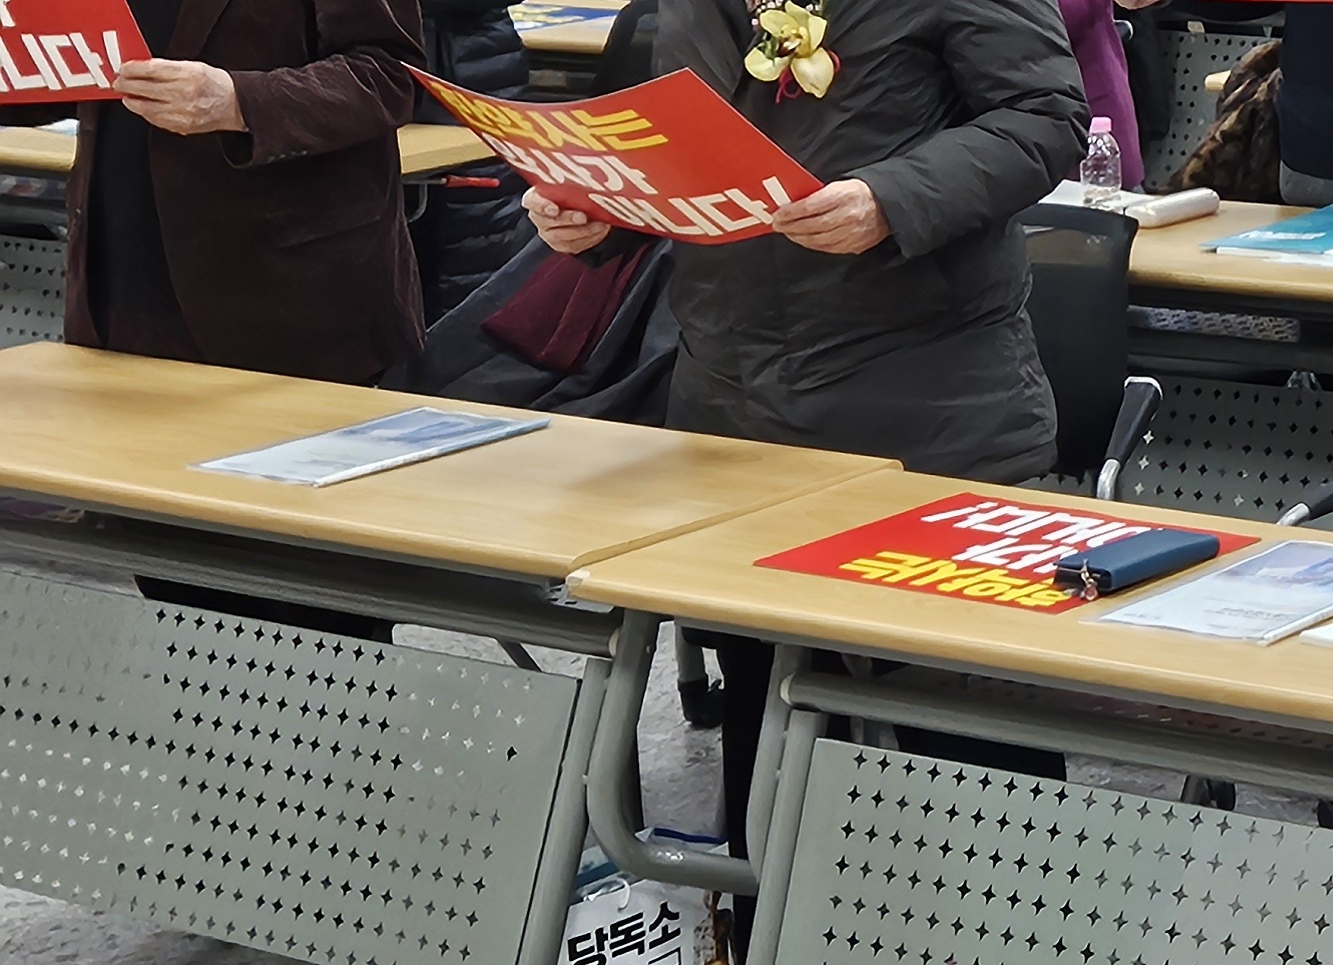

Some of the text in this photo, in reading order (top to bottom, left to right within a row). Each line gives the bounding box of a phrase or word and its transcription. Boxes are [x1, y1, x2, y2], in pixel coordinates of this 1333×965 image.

[428, 78, 670, 153] 한약사는
[479, 130, 659, 197] 약사가
[588, 174, 793, 238] 아니다!
[838, 550, 1074, 607] 한약사는
[566, 900, 682, 965] 당독소
